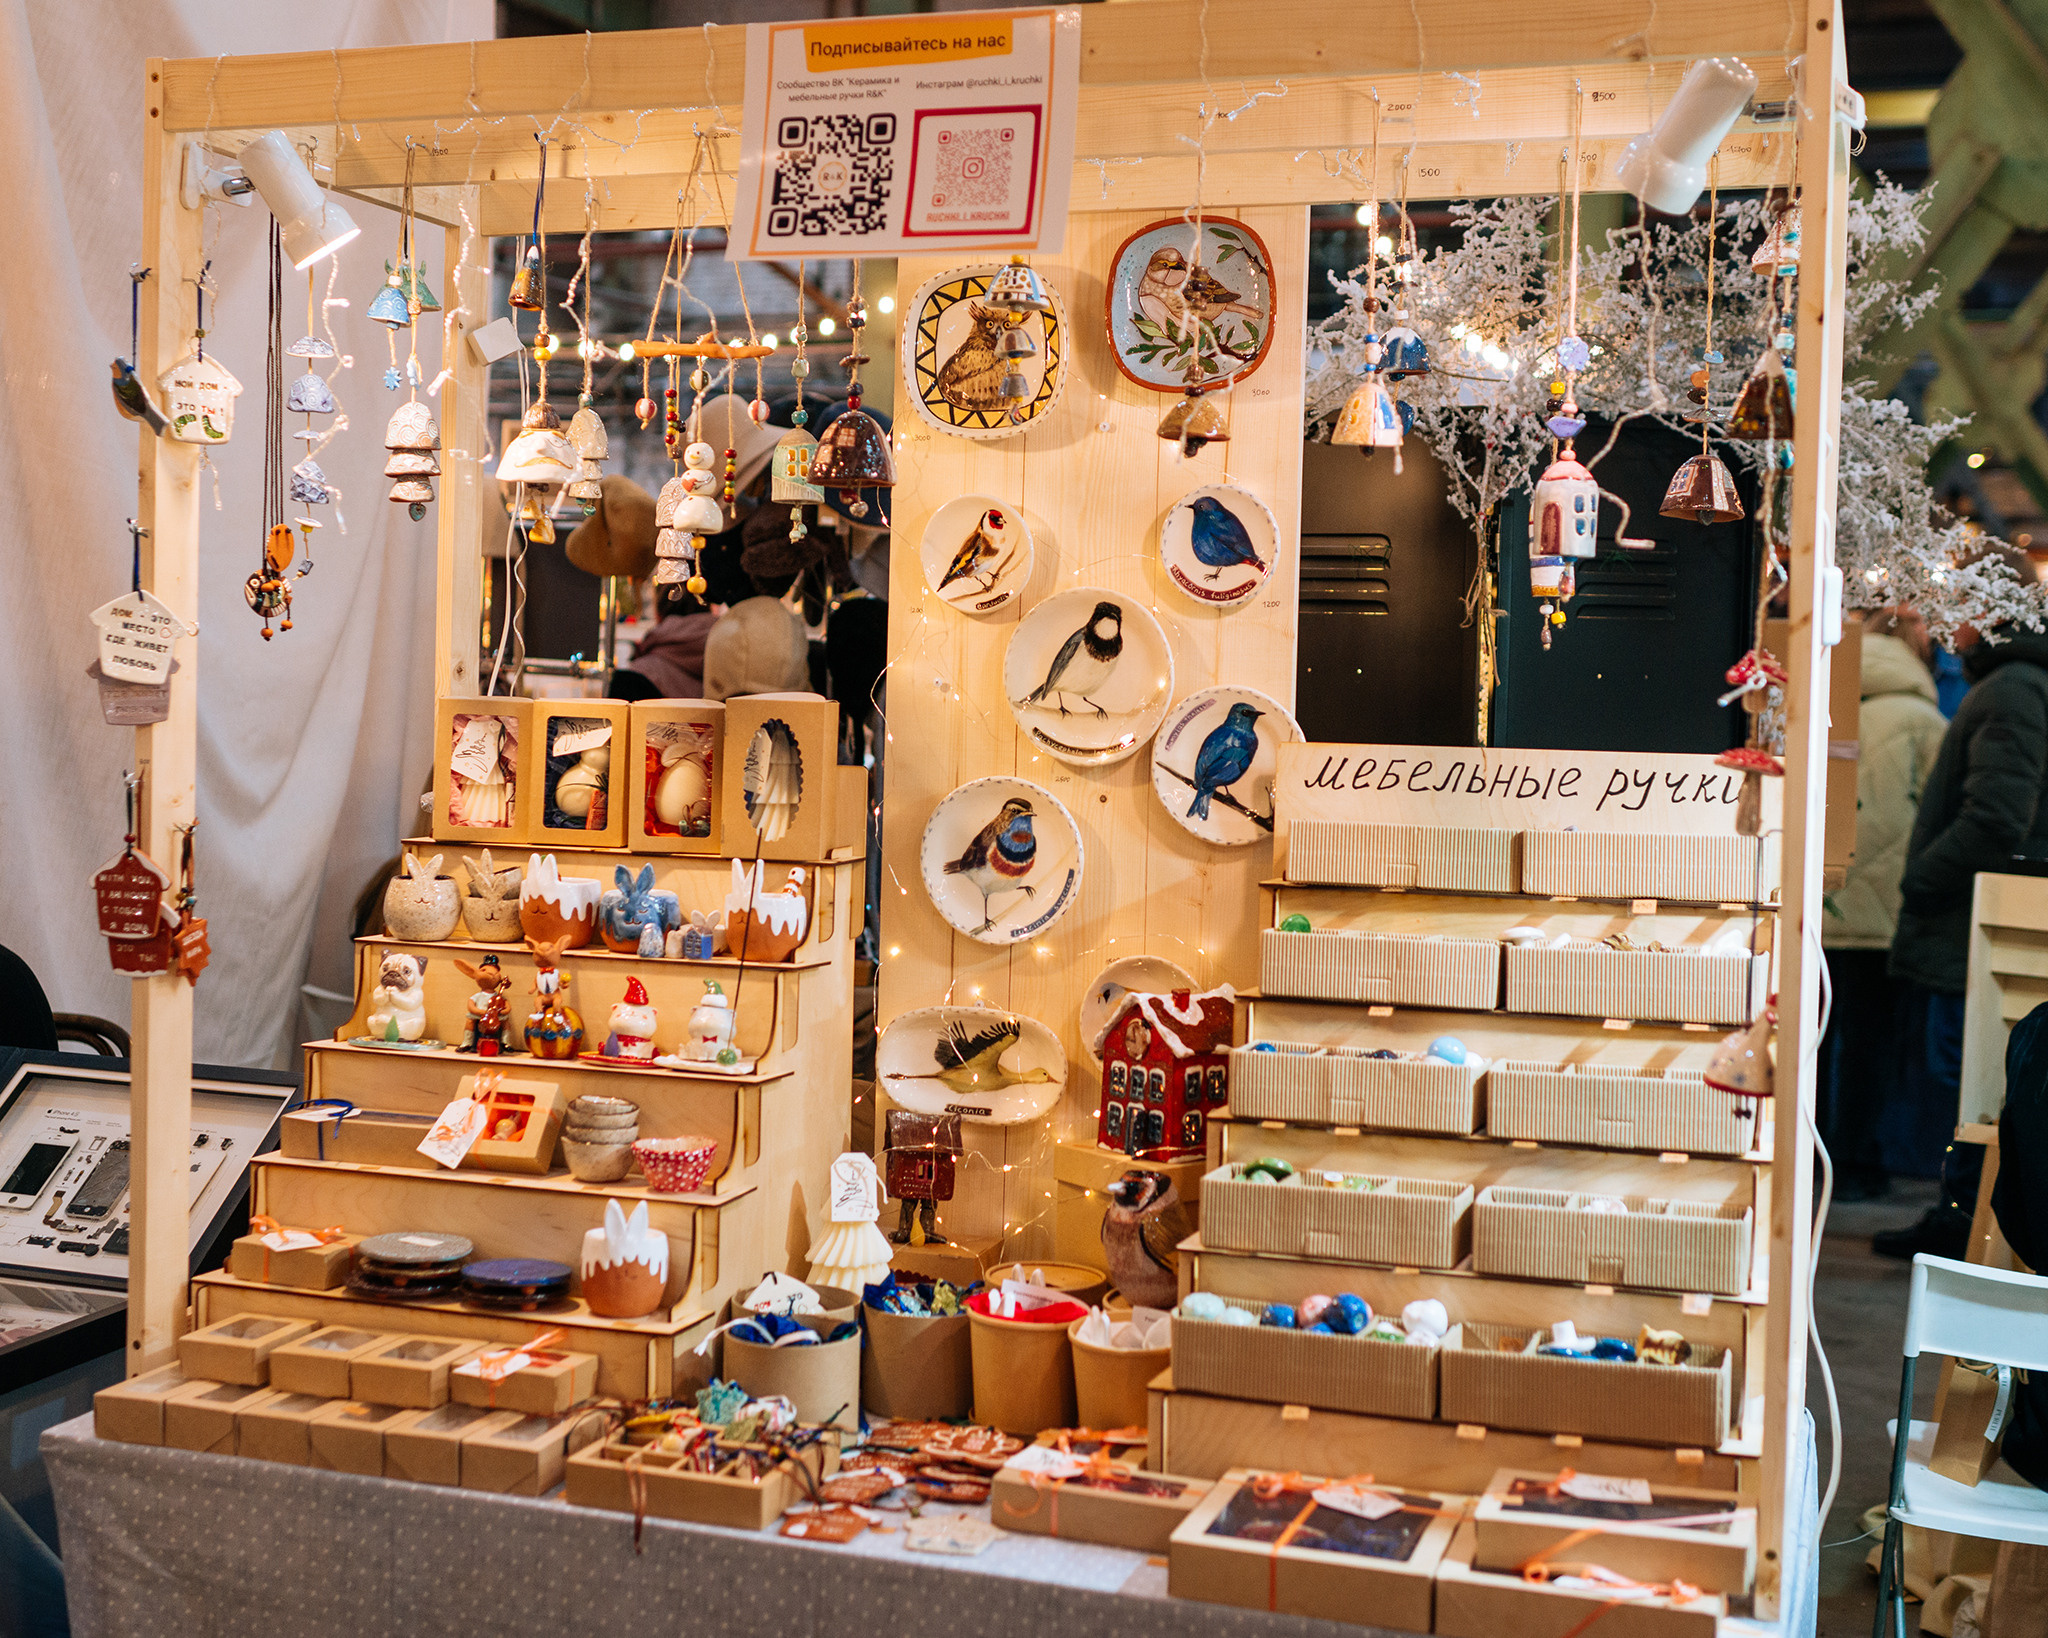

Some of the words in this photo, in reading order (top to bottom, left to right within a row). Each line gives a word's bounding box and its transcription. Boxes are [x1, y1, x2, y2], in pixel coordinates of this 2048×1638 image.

[810, 37, 948, 58] Подписывайтесь
[952, 37, 972, 49] на
[977, 35, 1006, 48] нас
[776, 79, 830, 90] Сообщество
[831, 78, 844, 87] ВК
[845, 76, 892, 87] "Керамика
[915, 80, 964, 89] Инстаграм
[788, 92, 838, 102] мебельные
[838, 91, 864, 101] ручки
[1387, 104, 1412, 112] 2000
[1417, 167, 1441, 178] 1500
[198, 382, 219, 391] ДОМ
[176, 402, 196, 412] ЭТО
[1263, 600, 1281, 608] 1200
[110, 607, 133, 619] ДОМ
[150, 614, 171, 625] ЭТО
[122, 621, 156, 635] МЕСТО
[105, 633, 126, 646] ГДЕ
[133, 639, 169, 654] ЖИВЕТ
[112, 655, 157, 671] ЛЮБОВЬ
[948, 1104, 987, 1116] Ciconia
